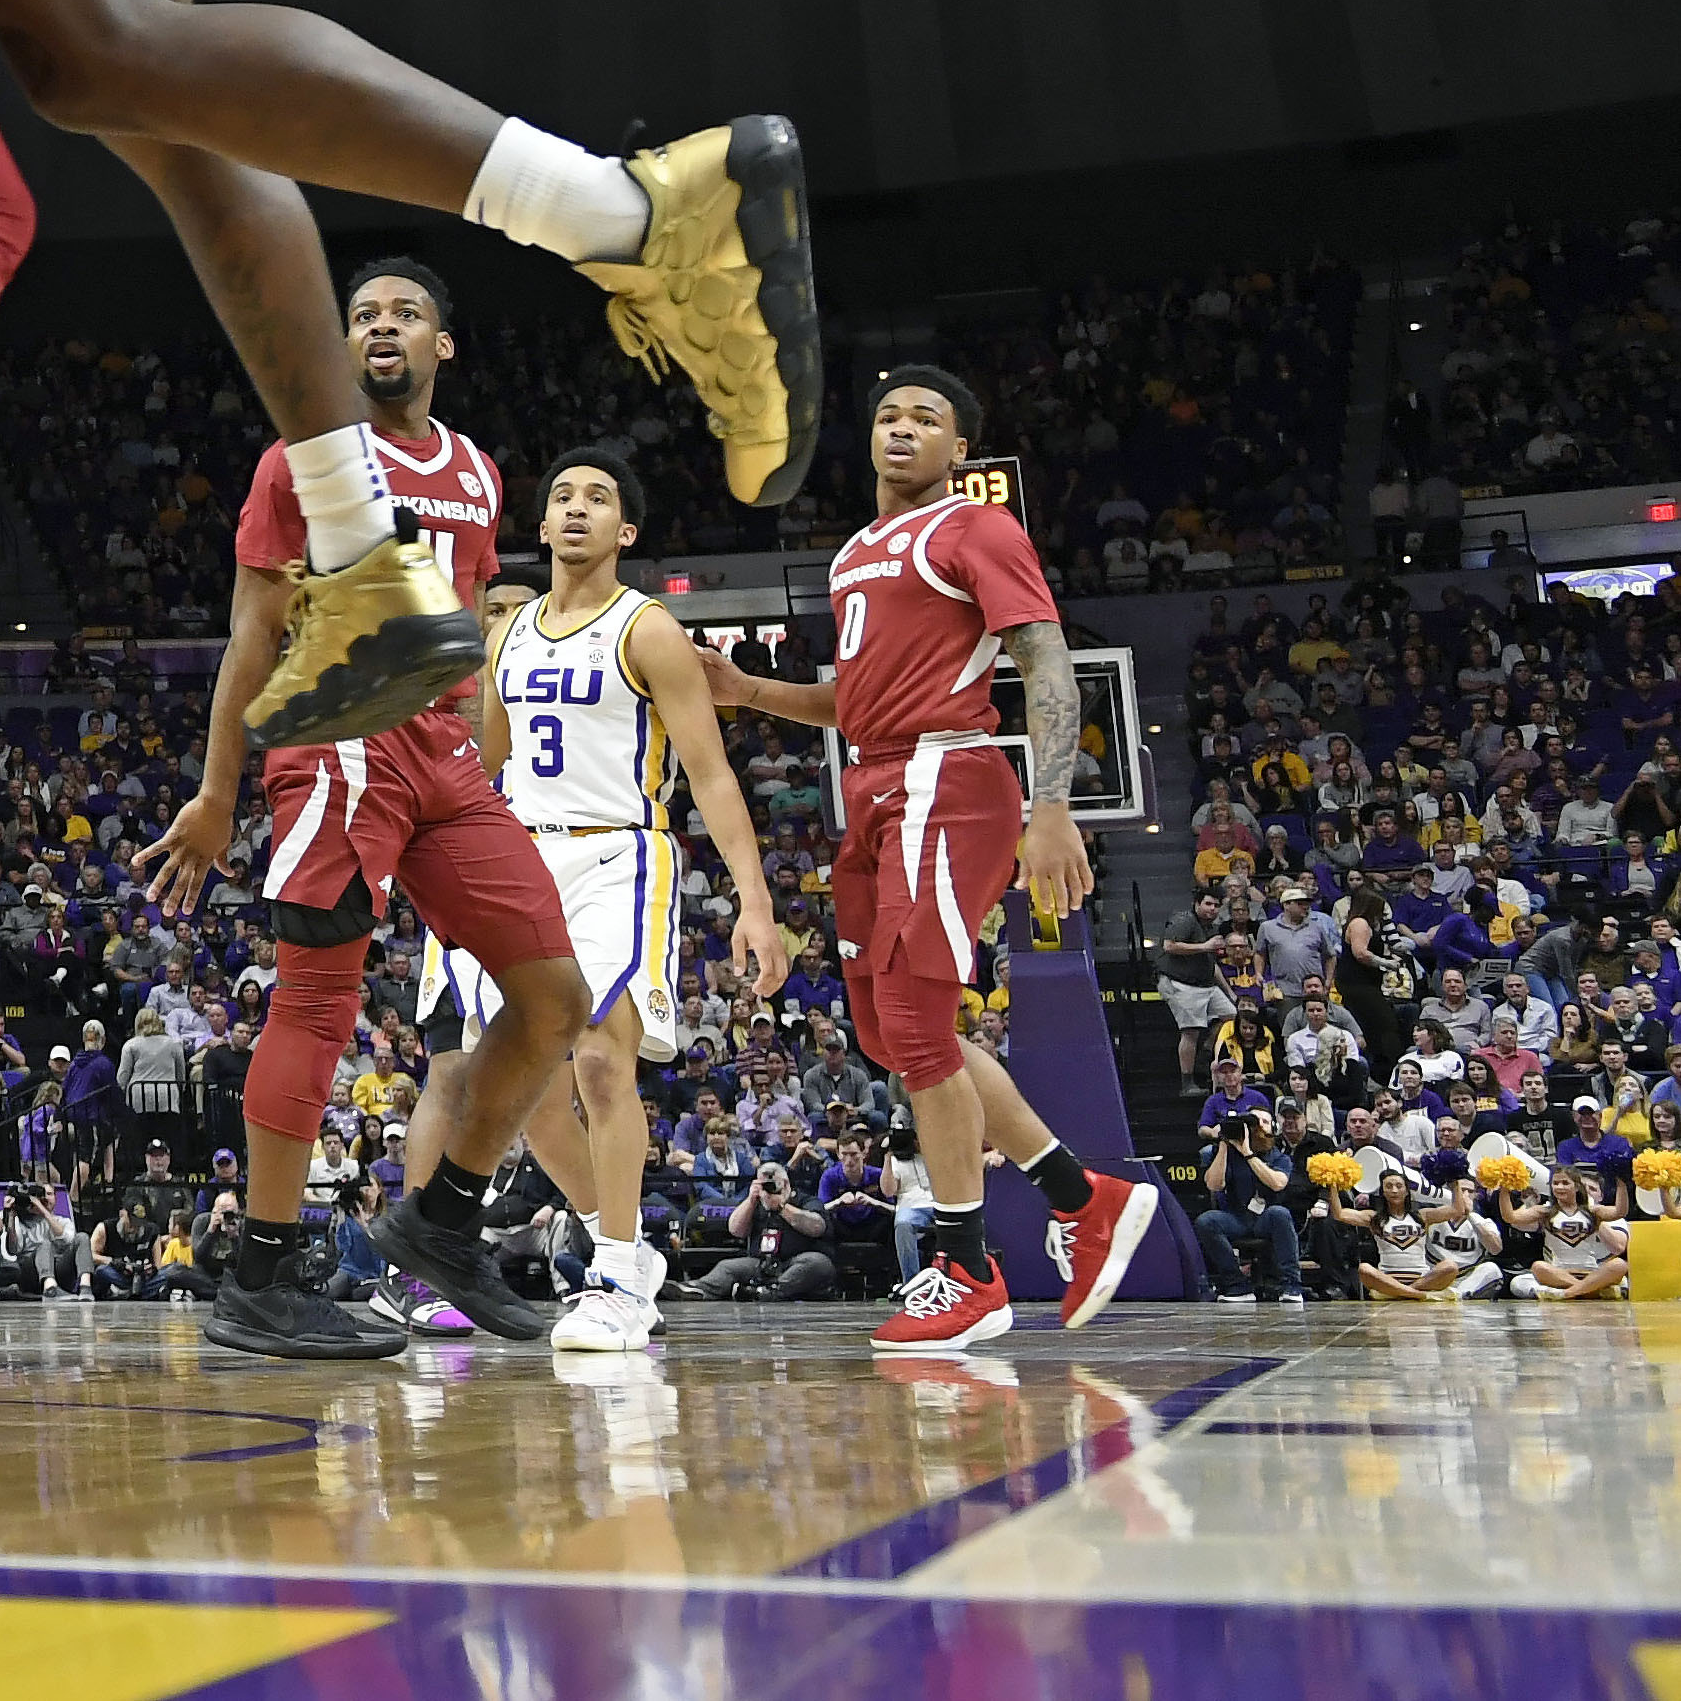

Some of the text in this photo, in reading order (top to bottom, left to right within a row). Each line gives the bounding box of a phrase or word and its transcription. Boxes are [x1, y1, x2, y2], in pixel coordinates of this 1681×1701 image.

[839, 591, 867, 661] 0
[502, 668, 604, 705] LSU
[529, 715, 564, 778] 3
[1167, 1166, 1197, 1181] 109
